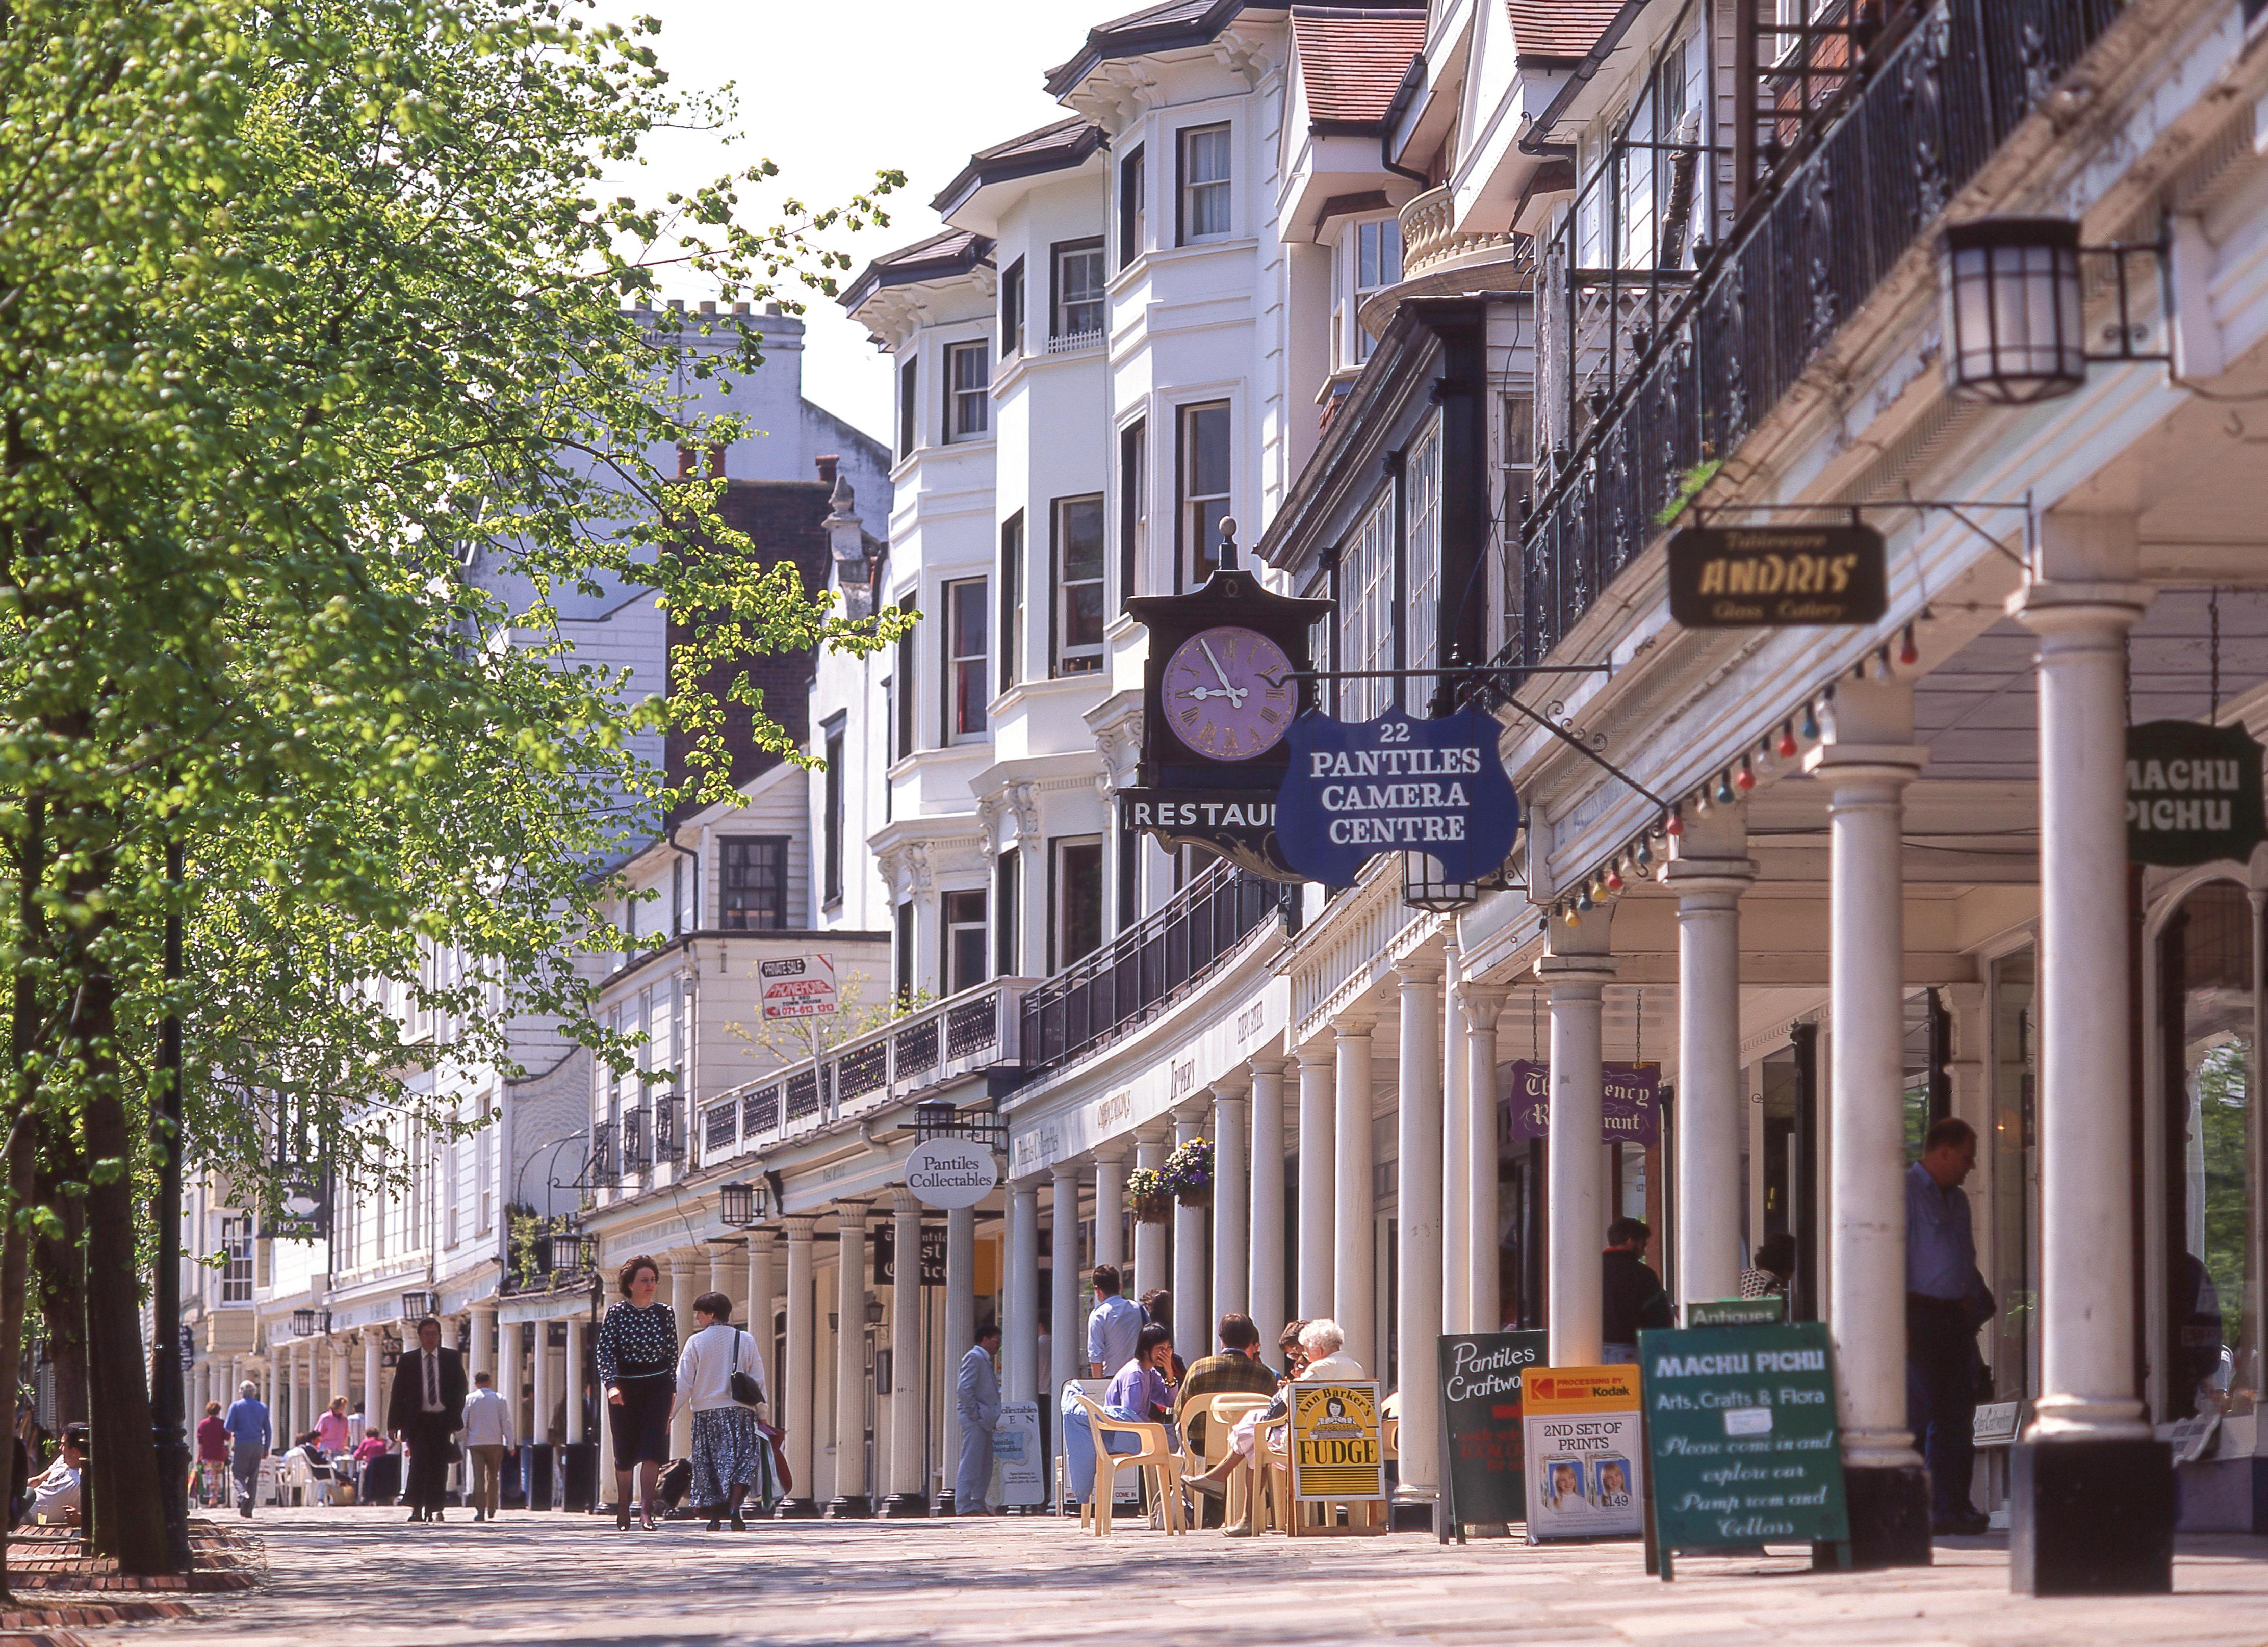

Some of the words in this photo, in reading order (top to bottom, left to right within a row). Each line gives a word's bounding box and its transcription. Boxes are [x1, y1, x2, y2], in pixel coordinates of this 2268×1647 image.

[1380, 723, 1411, 744] 22
[1310, 748, 1482, 778] PANTILES
[1322, 783, 1470, 811] CAMERA
[1135, 803, 1276, 826] RESTAU
[1329, 816, 1466, 845] CENTRE
[1525, 1072, 1550, 1096] Th
[1605, 1084, 1650, 1109] ency
[923, 1156, 980, 1171] Pantiles
[909, 1171, 992, 1188] Collectables
[278, 1221, 320, 1233] HOL
[922, 1233, 947, 1242] ntile
[922, 1244, 941, 1258] st
[1693, 1308, 1777, 1325] Antiques
[1453, 1342, 1535, 1376] Pantiles
[1656, 1354, 1750, 1378] MACHU
[1756, 1349, 1826, 1374] PICHU
[1557, 1378, 1610, 1387] PROCESSING
[1592, 1385, 1630, 1397] Kodak
[1299, 1395, 1320, 1417] Ann
[1322, 1387, 1372, 1417] Barker's
[1699, 1389, 1754, 1408] Crafts
[1758, 1388, 1773, 1406] &
[1779, 1387, 1826, 1405] Flora
[1544, 1425, 1573, 1437] 2ND
[1577, 1423, 1601, 1435] SET
[1603, 1422, 1622, 1433] OF
[1299, 1439, 1378, 1465] FUDGE
[1558, 1437, 1609, 1450] PRINTS
[1659, 1435, 1721, 1457] Please
[1726, 1441, 1772, 1453] come
[1776, 1436, 1794, 1451] in
[1796, 1429, 1833, 1450] and
[1701, 1461, 1769, 1487] explore
[1772, 1465, 1808, 1478] our
[1673, 1492, 1740, 1515] Pump
[1744, 1495, 1784, 1507] room
[1788, 1484, 1828, 1505] and
[1716, 1515, 1794, 1537] Cellars
